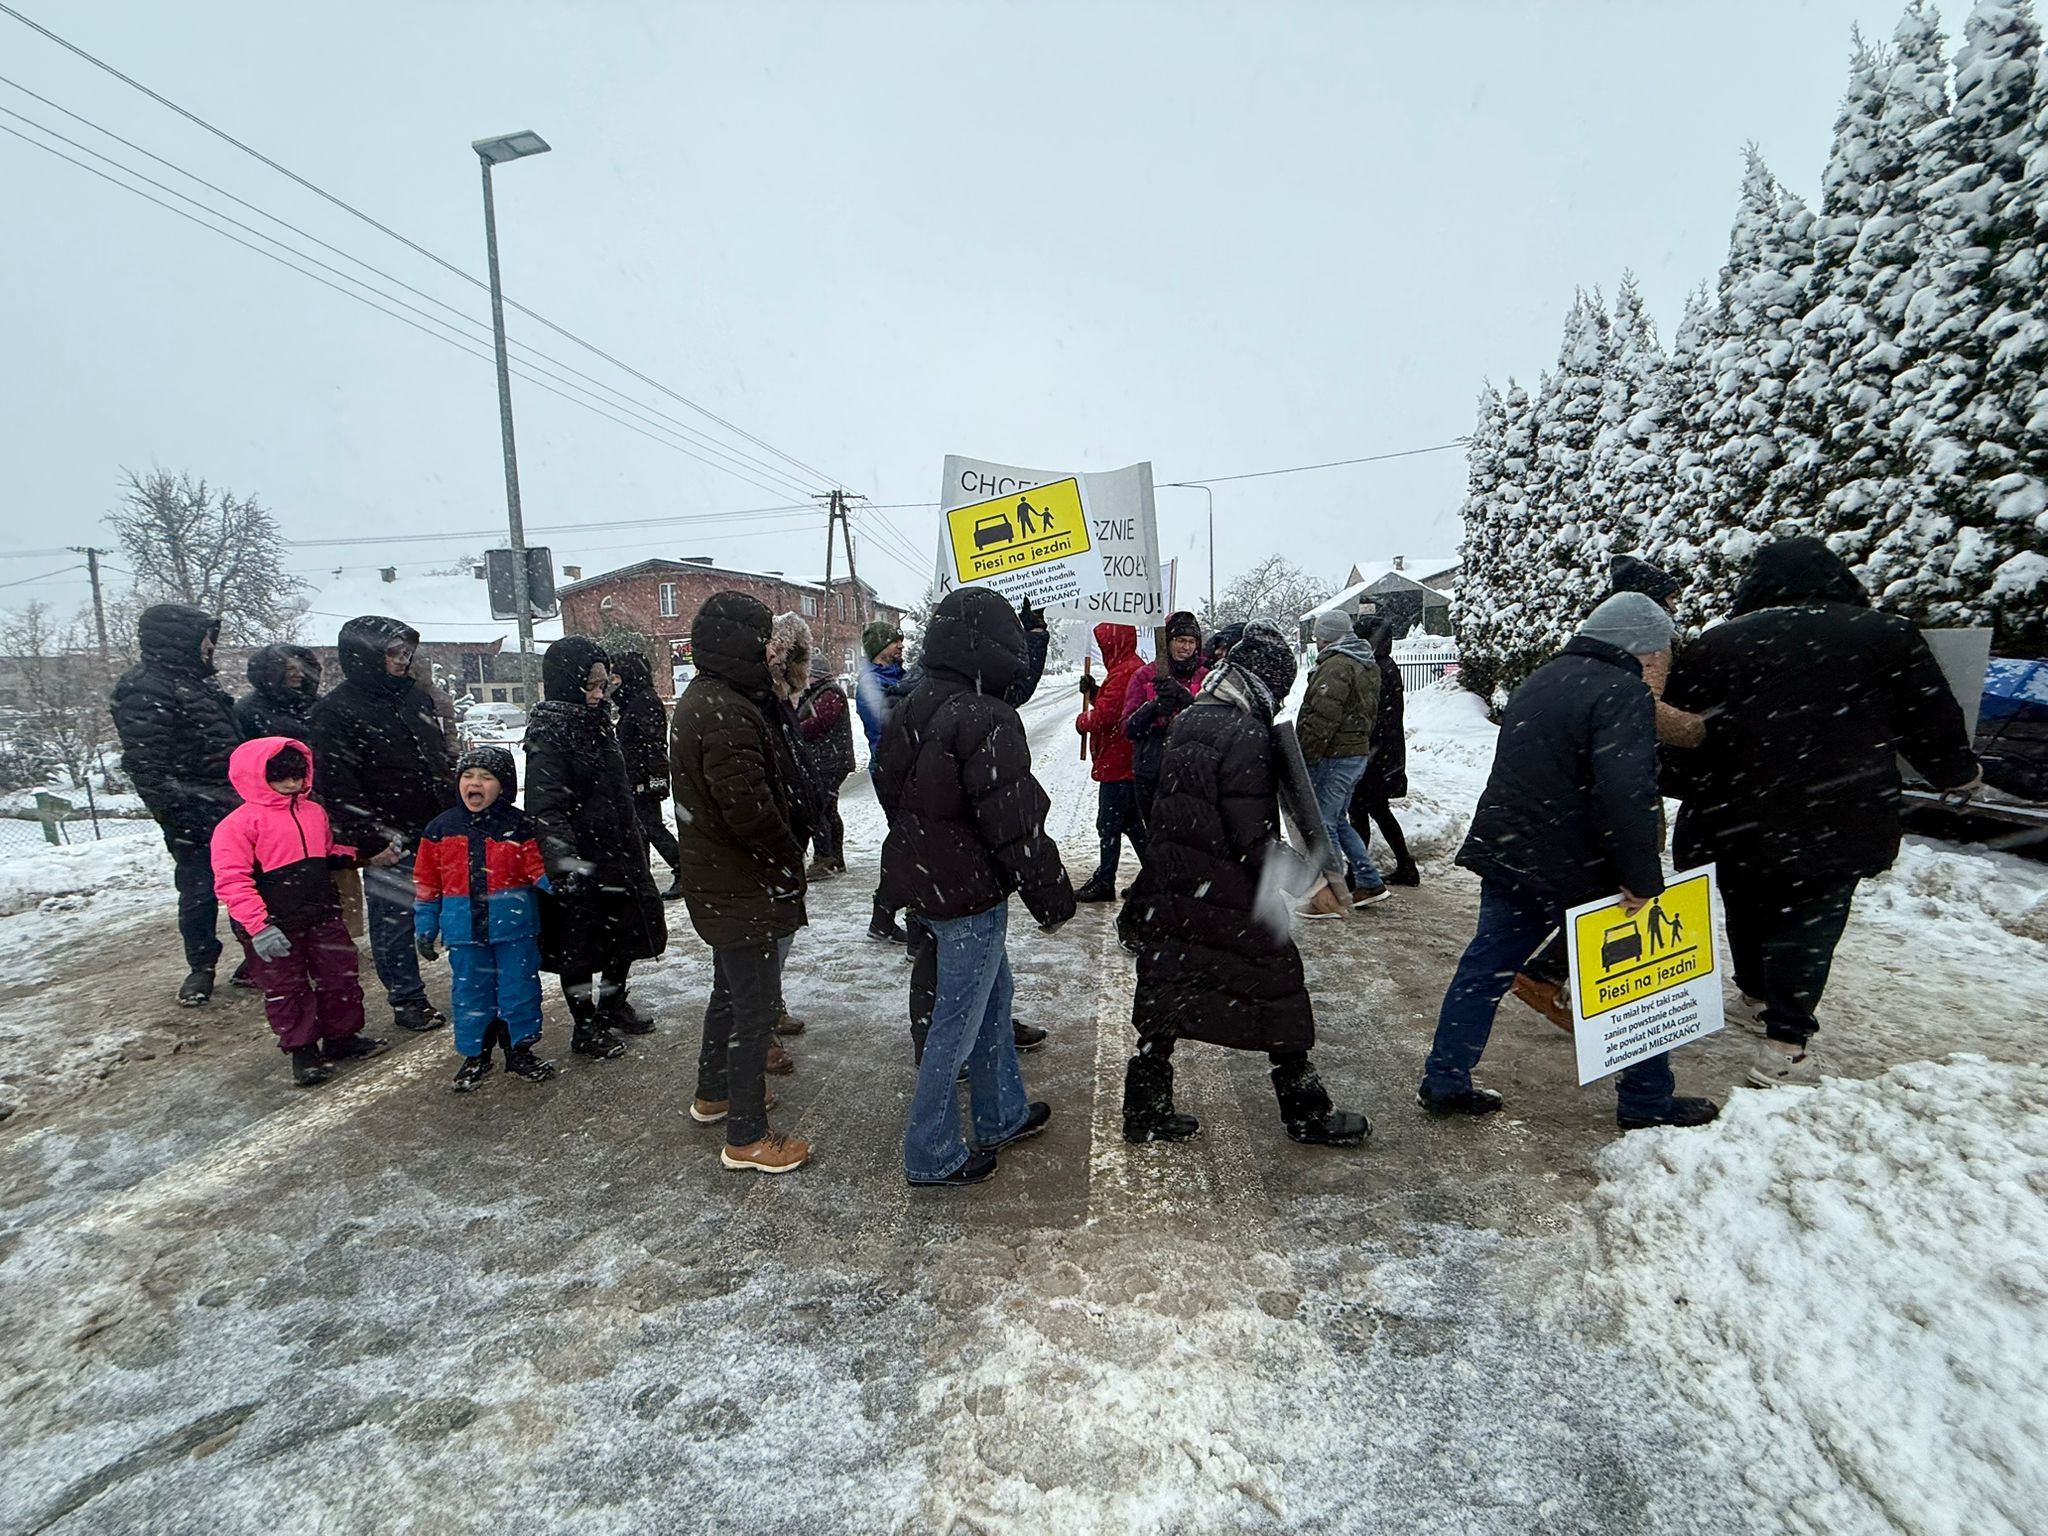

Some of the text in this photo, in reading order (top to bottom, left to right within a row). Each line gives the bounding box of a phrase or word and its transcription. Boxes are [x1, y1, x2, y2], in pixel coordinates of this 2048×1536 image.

[961, 470, 1039, 496] CHC
[974, 538, 1072, 572] Piesi na jezdni
[987, 562, 1066, 589] Tu miał być taki znak
[1004, 569, 1076, 595] powstanie chodnik
[1023, 588, 1039, 598] NIE
[1039, 583, 1054, 595] MA
[1055, 580, 1077, 591] czasu
[1088, 591, 1162, 615] SKLEPU!
[1599, 954, 1697, 1003] Piesi na jezdni
[1604, 998, 1698, 1041] zanim powstanie chodnik
[1610, 987, 1689, 1025] Tu miał być taki znak
[1604, 1022, 1701, 1068] ufundowali MIESZKAŃCY
[1606, 1012, 1698, 1054] ale powiat NIE MA czasu
